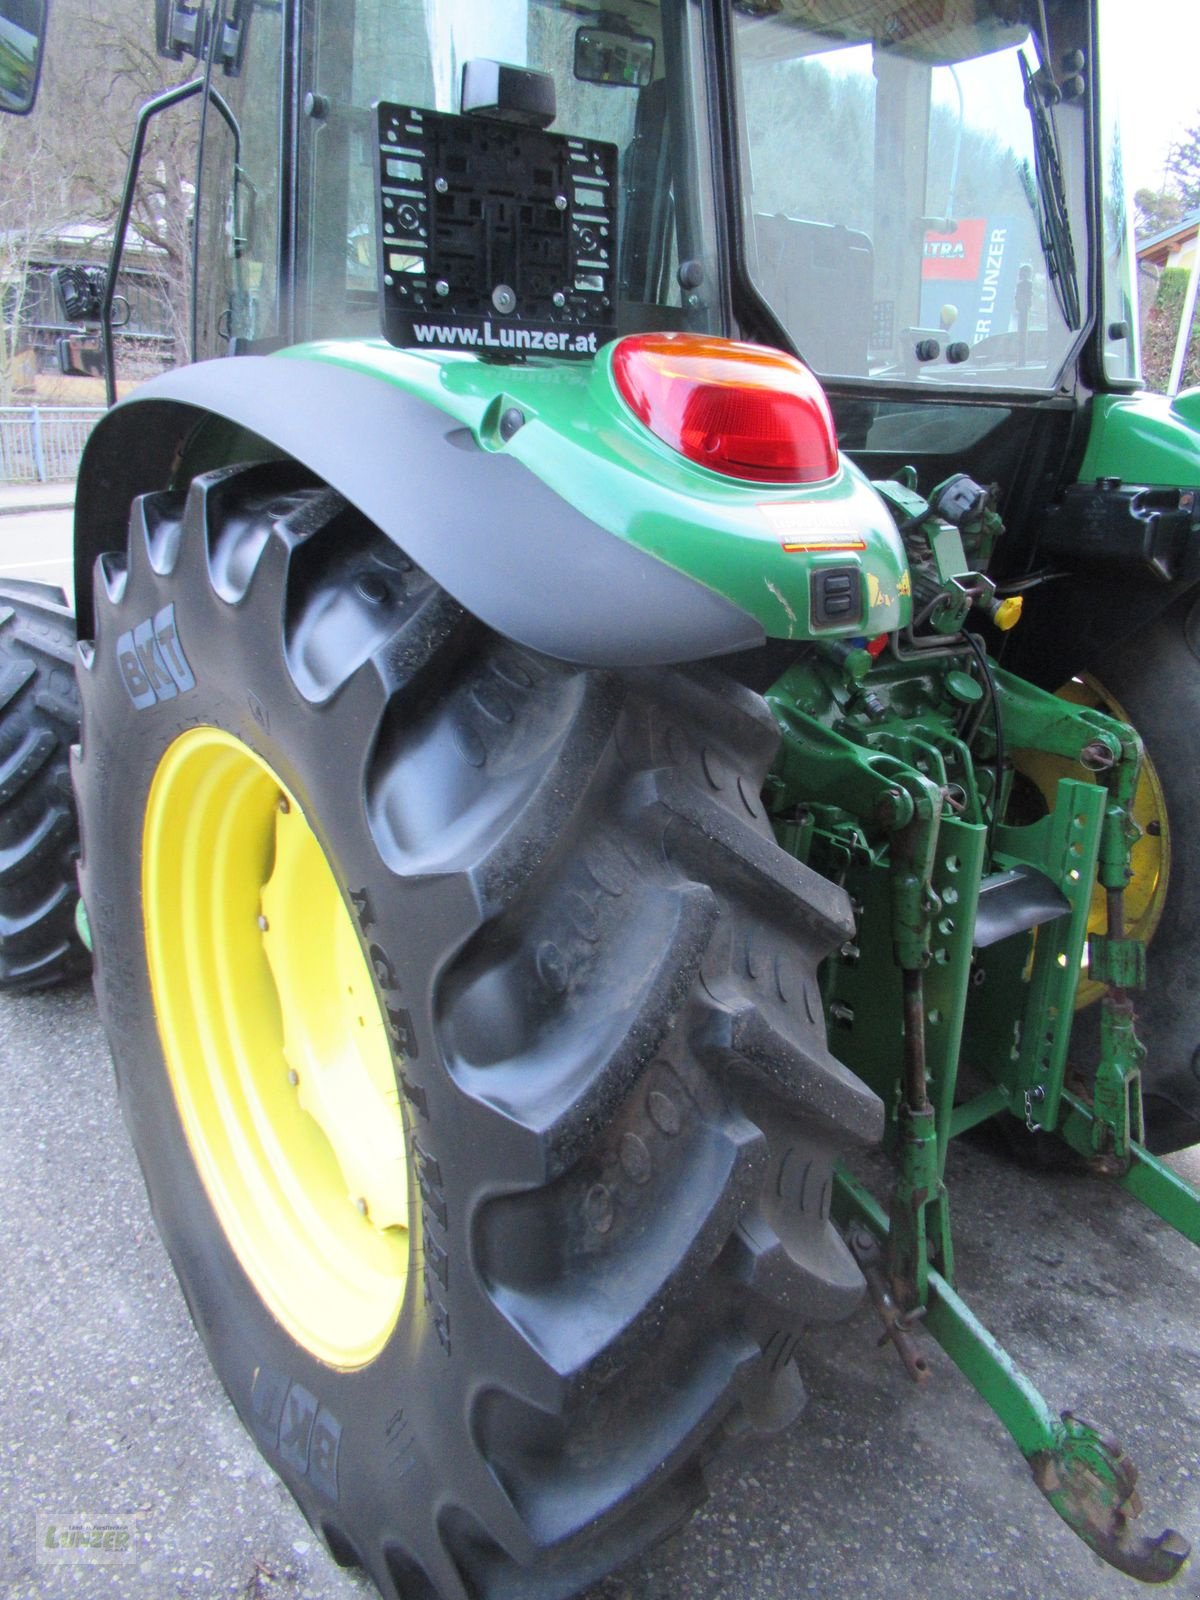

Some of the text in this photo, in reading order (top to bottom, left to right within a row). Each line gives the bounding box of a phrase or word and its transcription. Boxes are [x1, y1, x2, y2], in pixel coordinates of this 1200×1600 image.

[978, 228, 1007, 314] LUNZER
[413, 321, 597, 353] www.Lunzer.at
[116, 602, 196, 710] BKT
